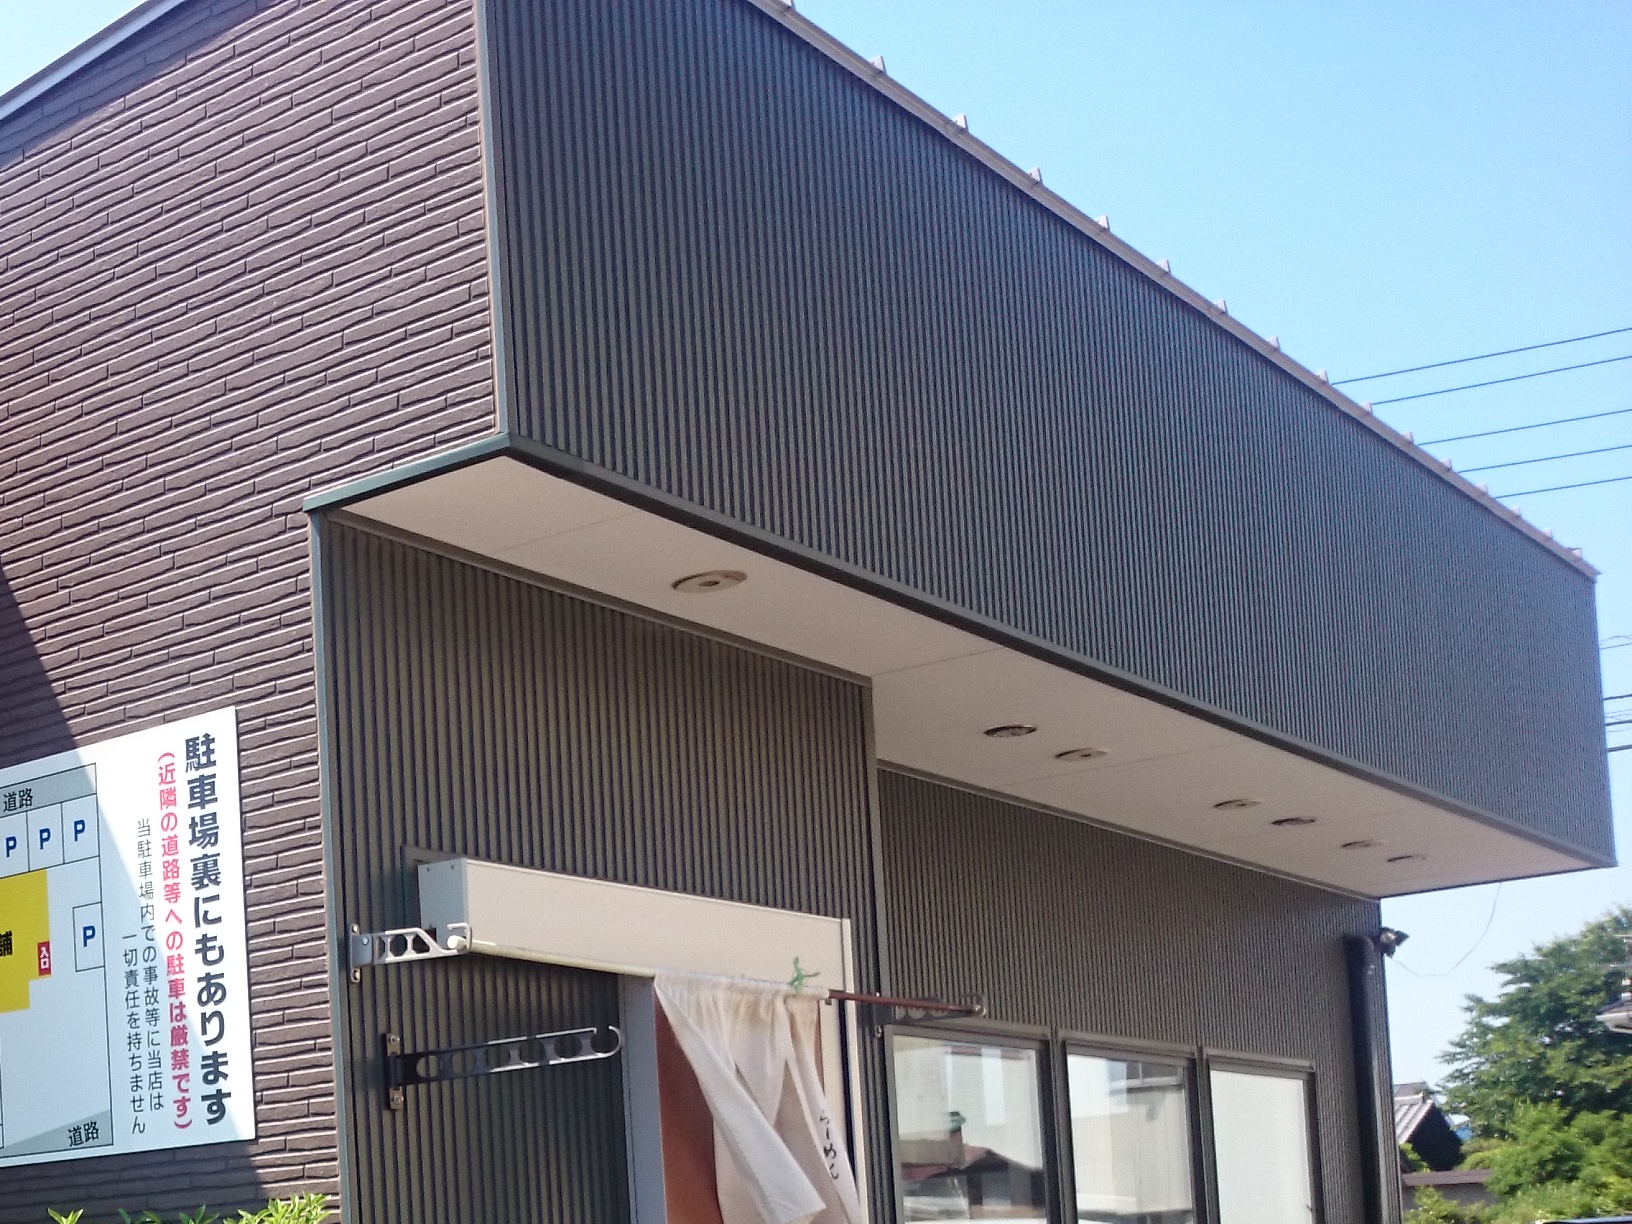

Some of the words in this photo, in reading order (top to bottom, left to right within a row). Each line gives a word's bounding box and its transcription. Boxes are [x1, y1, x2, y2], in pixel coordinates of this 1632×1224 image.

[2, 787, 34, 813] 道路
[5, 836, 18, 858] P
[39, 827, 52, 850] P
[73, 819, 86, 842] P
[82, 924, 97, 948] P
[184, 732, 233, 1127] 駐車場裏にもあります
[39, 946, 50, 970] 入口
[136, 817, 165, 1112] 当駐車場内での事故等に当店は
[121, 933, 147, 1135] 一切責任を持ちません
[67, 1120, 100, 1148] 道路
